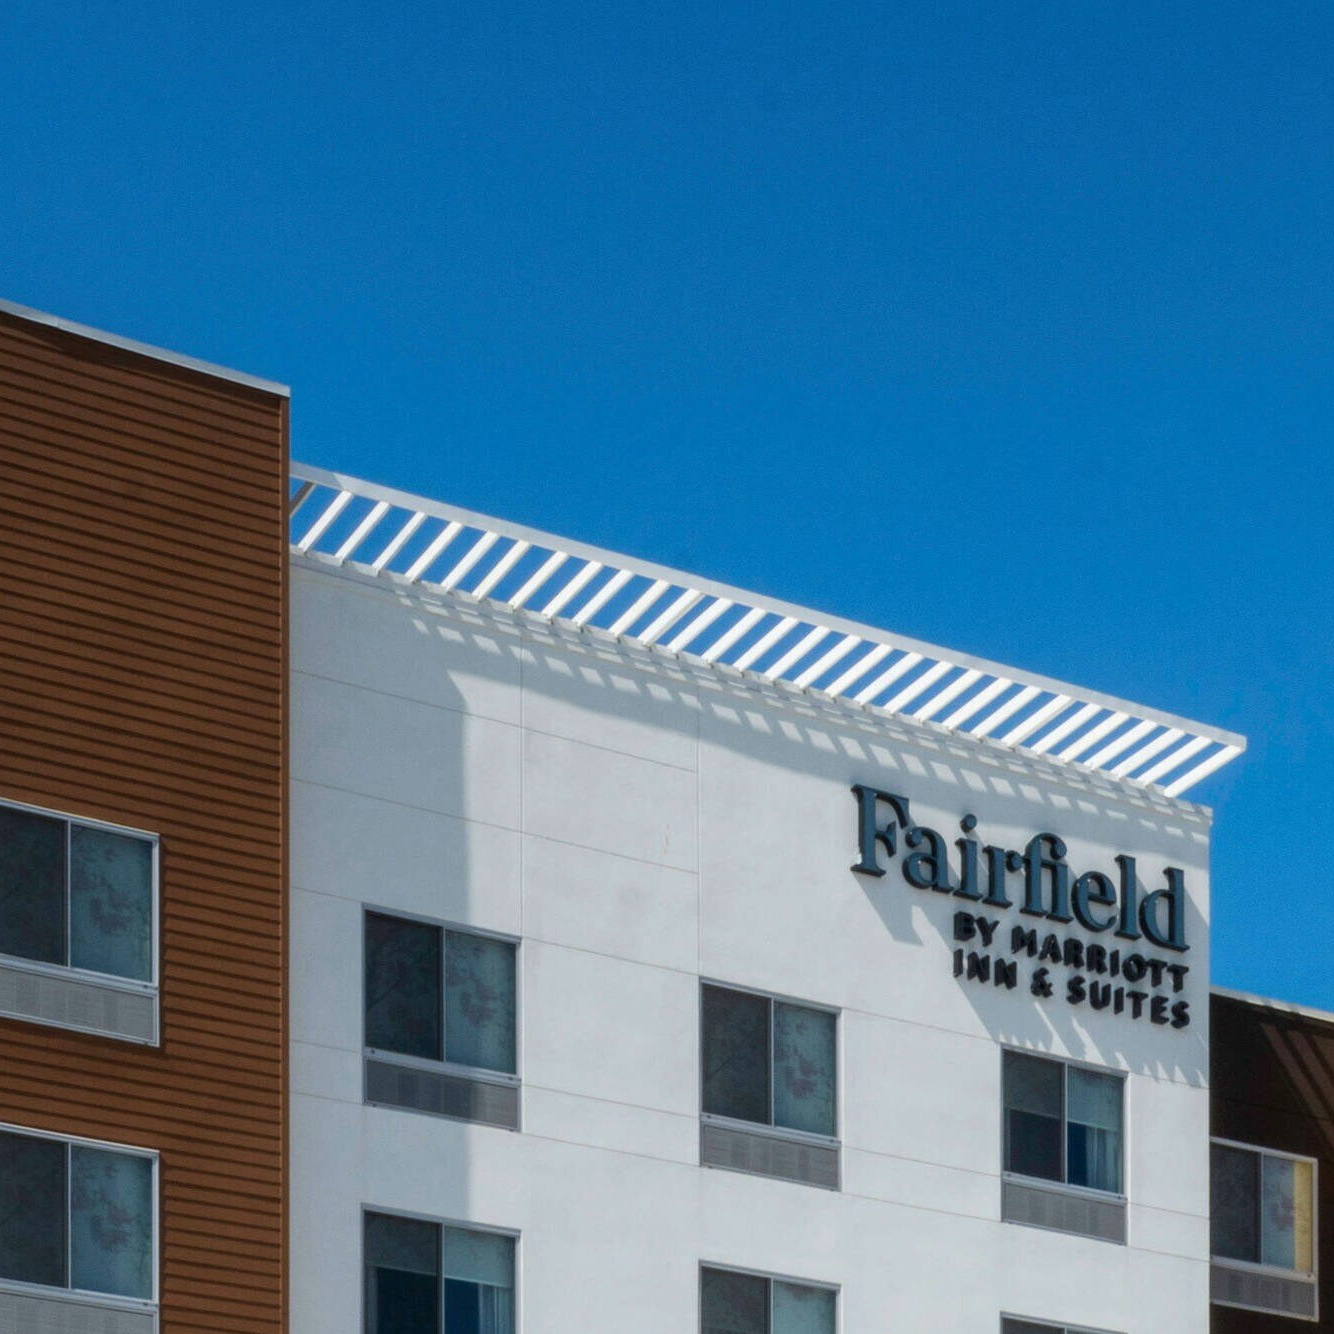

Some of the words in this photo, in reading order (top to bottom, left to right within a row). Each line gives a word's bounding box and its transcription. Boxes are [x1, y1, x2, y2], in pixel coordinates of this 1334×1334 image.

[850, 783, 1190, 953] Fairfield
[953, 911, 1000, 947] BY
[1011, 924, 1190, 993] MARRIOTT
[953, 948, 1018, 989] INN
[1030, 966, 1053, 997] &
[1066, 974, 1190, 1029] SUITES
